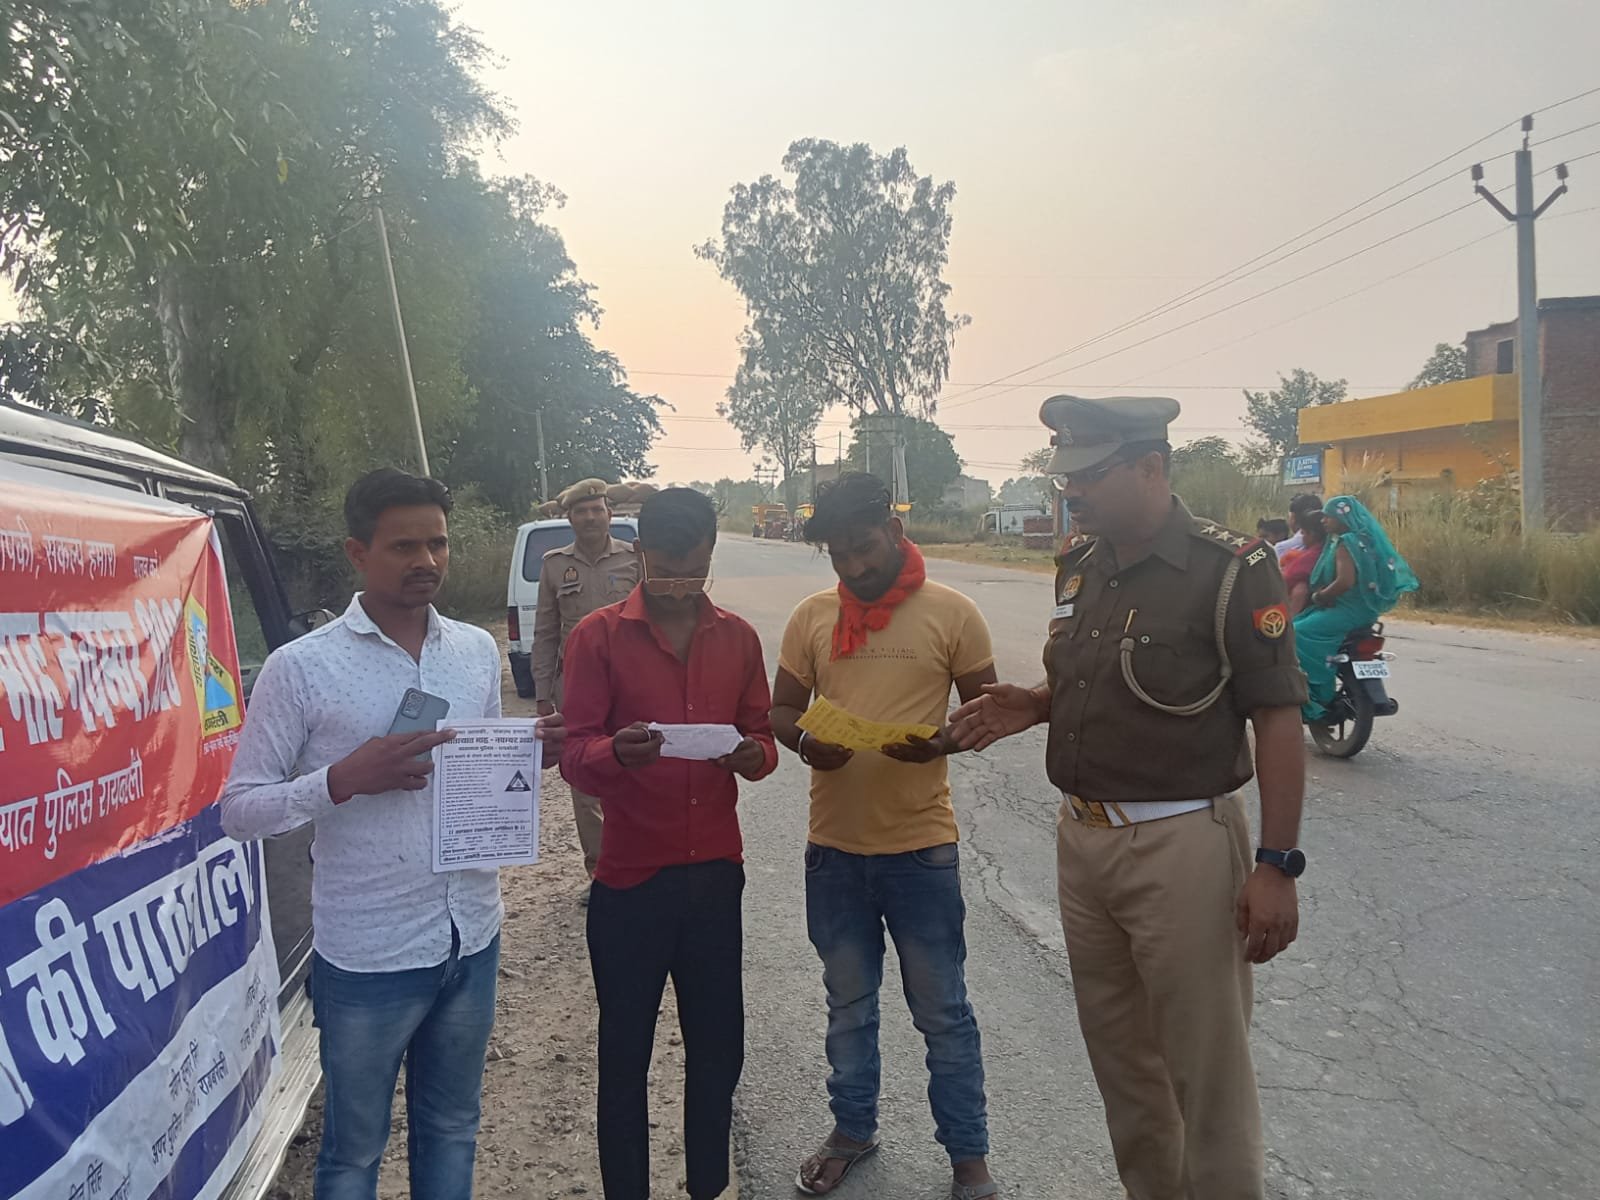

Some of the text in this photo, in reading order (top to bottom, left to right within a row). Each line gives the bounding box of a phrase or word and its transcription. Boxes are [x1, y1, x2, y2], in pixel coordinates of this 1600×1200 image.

[86, 540, 116, 580] हमारा
[44, 768, 94, 860] पुलिस
[6, 897, 117, 1067] की
